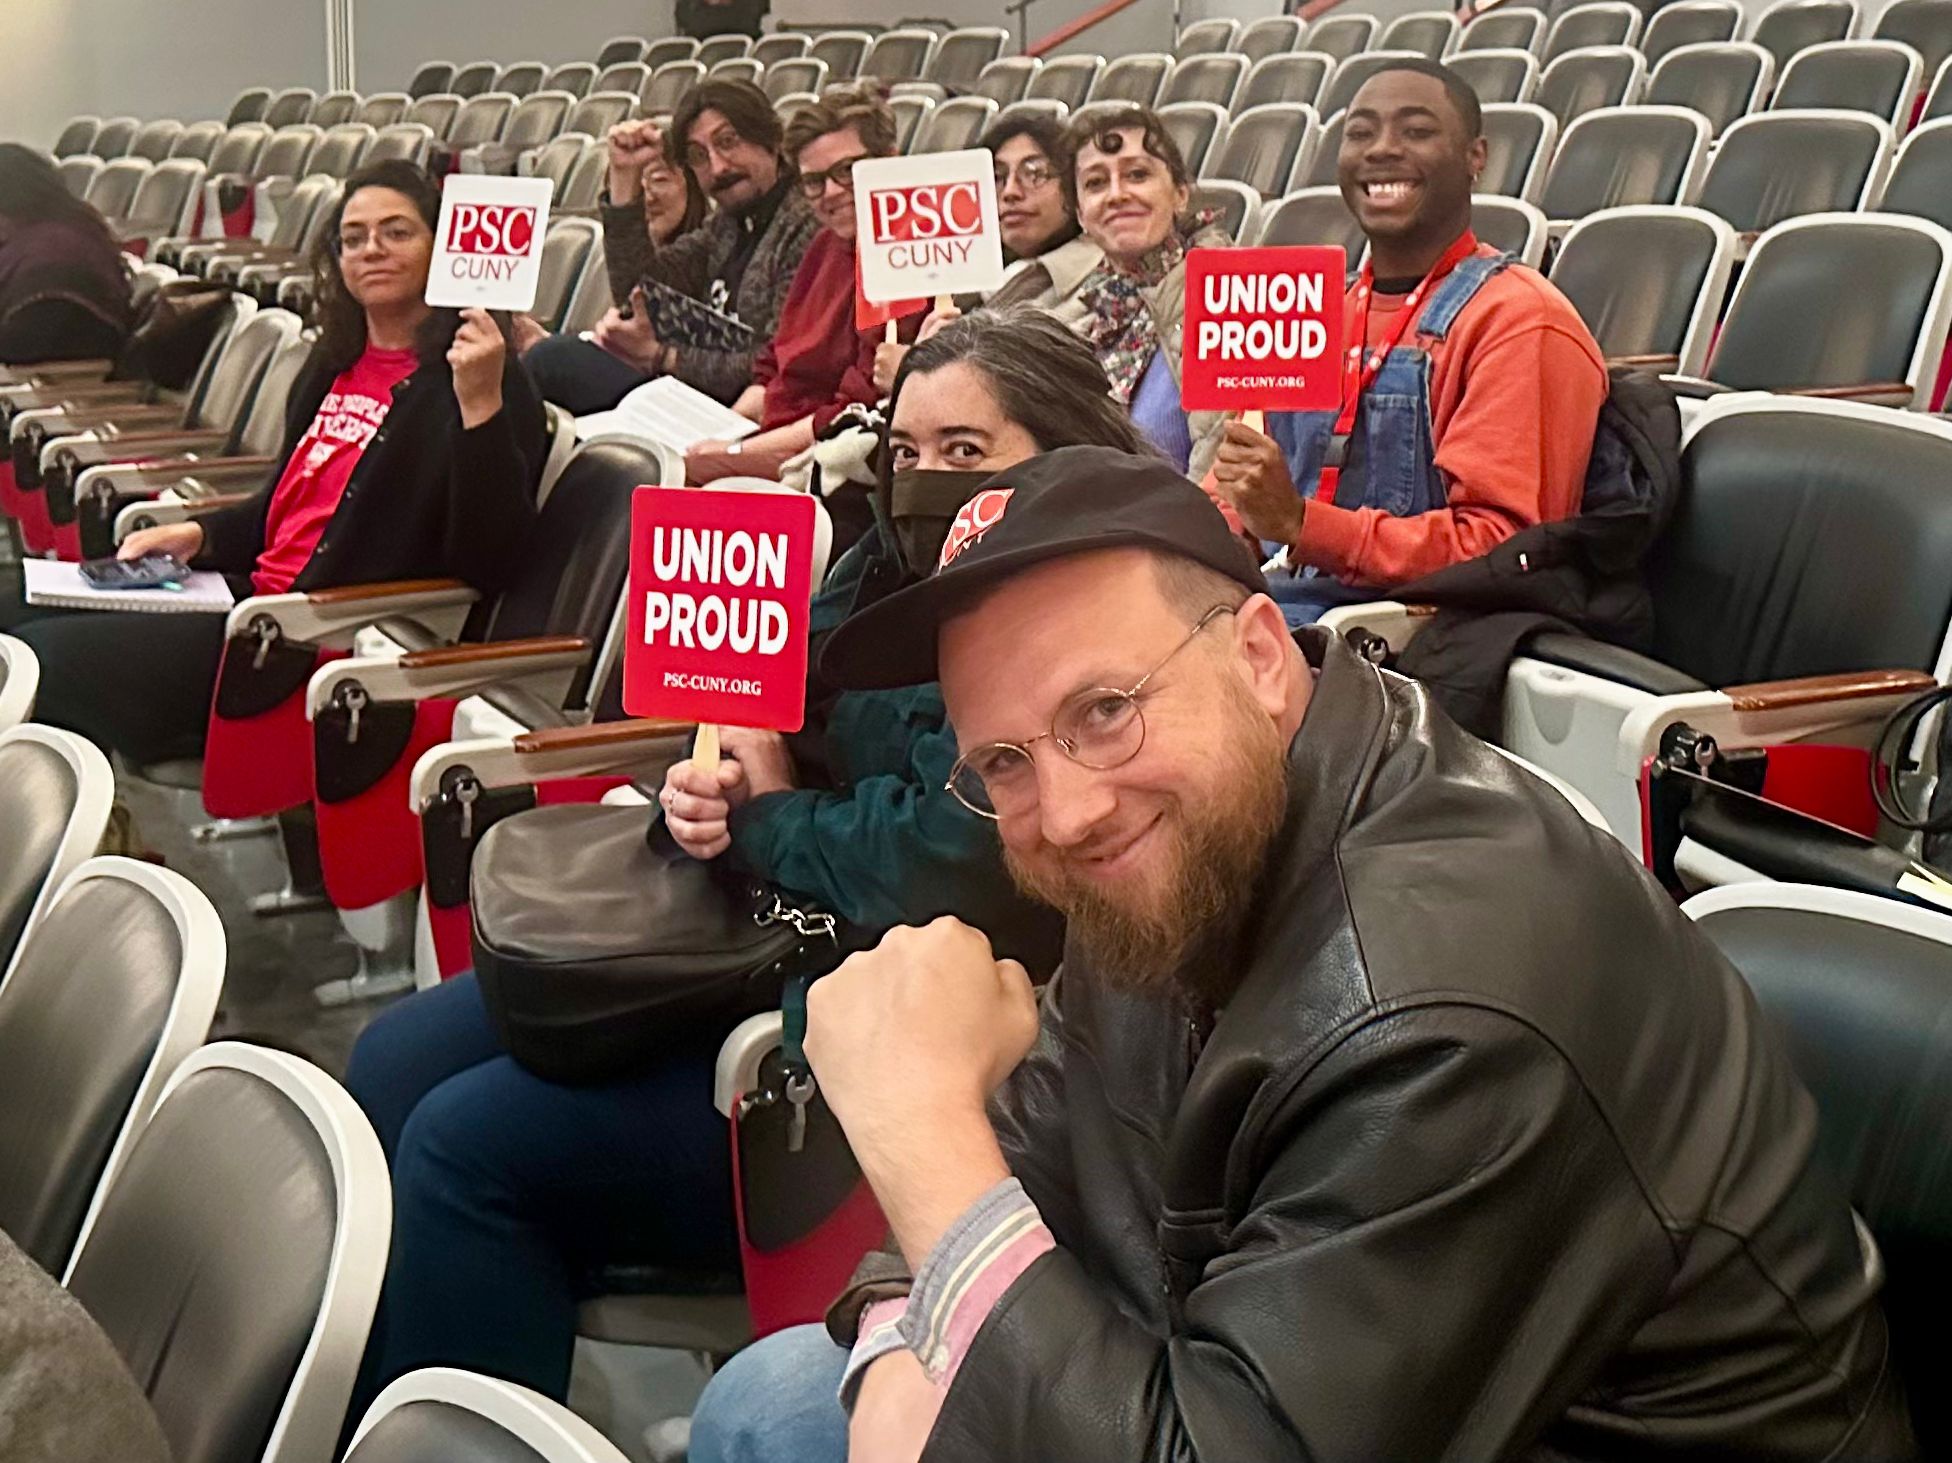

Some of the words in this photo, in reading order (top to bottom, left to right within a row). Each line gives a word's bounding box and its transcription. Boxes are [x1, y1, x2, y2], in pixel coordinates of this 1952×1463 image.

[448, 205, 535, 255] PSC
[872, 183, 981, 242] PSC
[451, 256, 519, 281] CUNY
[888, 239, 973, 269] CUNY
[1204, 272, 1324, 315] UNION
[1198, 319, 1327, 360] PROUD
[1216, 376, 1306, 388] PSC-CUNY.ORG
[939, 489, 1014, 567] SC
[653, 526, 788, 589] UNION
[644, 591, 789, 655] PROUD
[663, 672, 762, 695] PSC-CUNY.ORG
